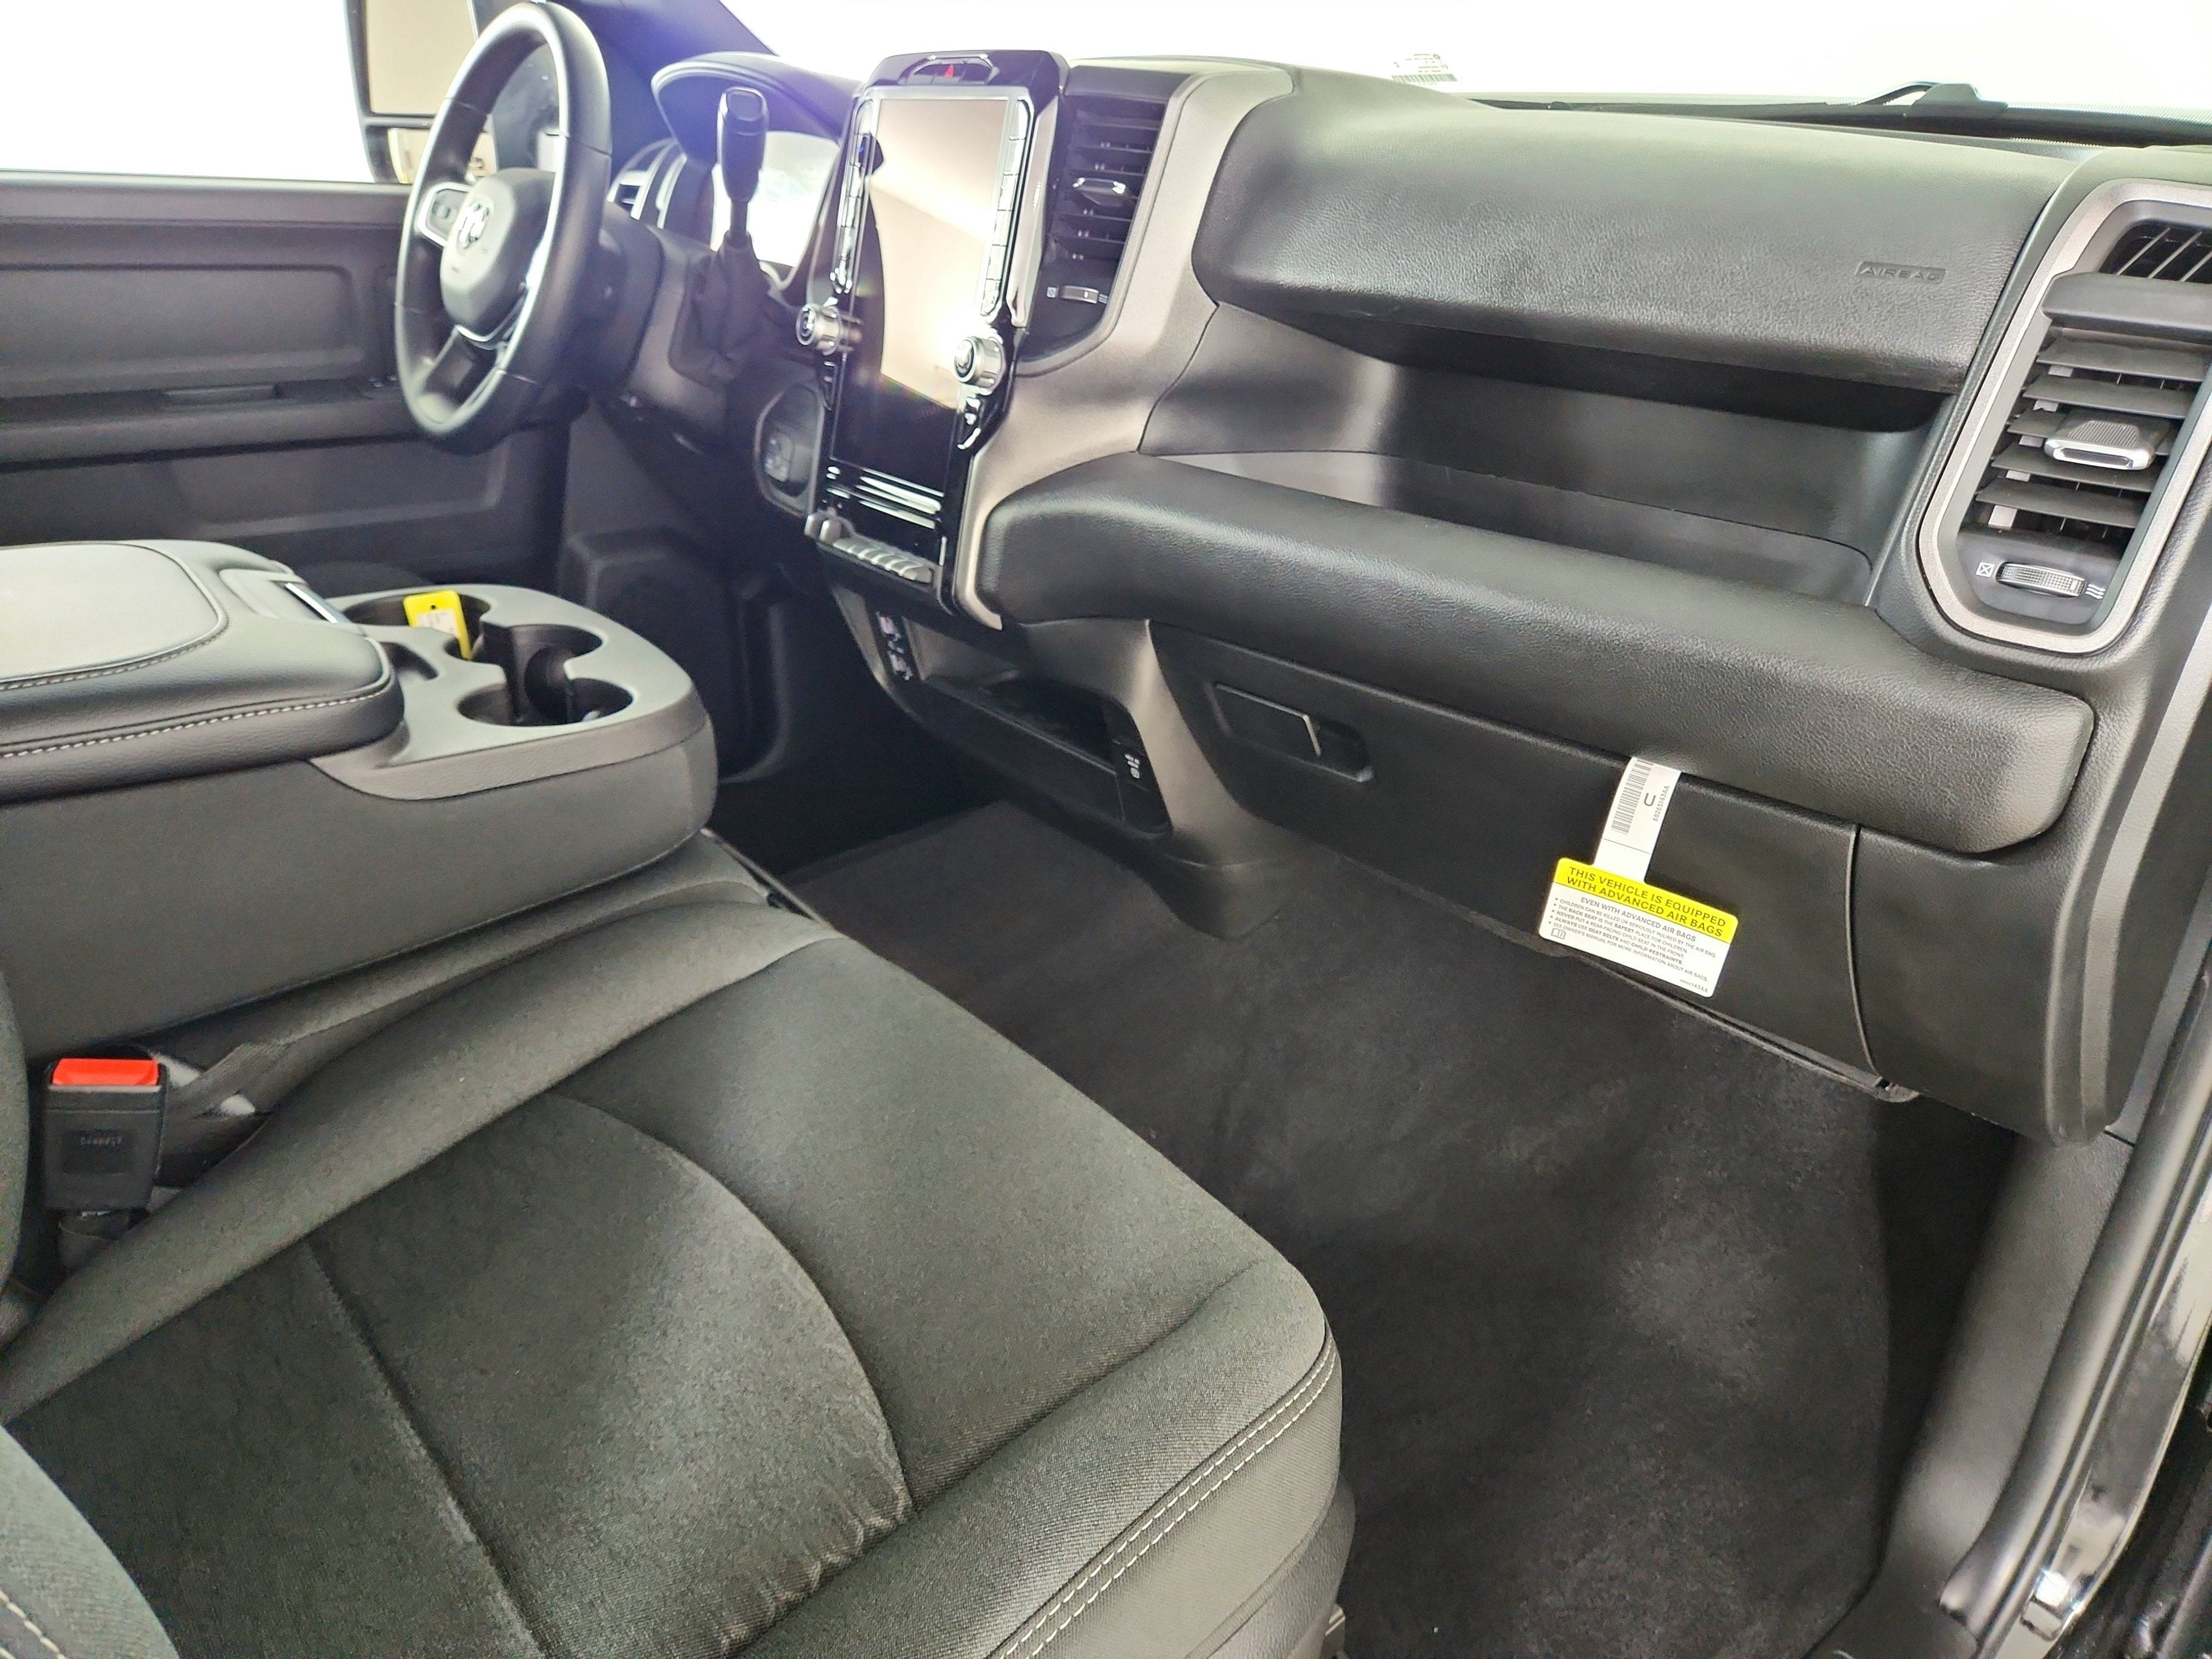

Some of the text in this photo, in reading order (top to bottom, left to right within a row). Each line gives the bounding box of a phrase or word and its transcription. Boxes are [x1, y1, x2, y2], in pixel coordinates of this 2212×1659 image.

[1860, 267, 1940, 280] AIRBAG
[1652, 786, 1670, 822] 68265143AA
[1566, 877, 1723, 938] WITH ADVANCED AIR BAGS
[1568, 867, 1726, 928] THIS VEHICLE IS EQUIPPED
[1555, 917, 1578, 928] ALWAYS
[1602, 933, 1619, 941] BELTS
[1630, 943, 1648, 952] CHILD
[1556, 911, 1575, 920] NEVER
[1622, 933, 1637, 941] CHILD
[1560, 899, 1584, 910] CHILDREN
[1603, 913, 1620, 922] KILLED
[1629, 922, 1656, 935] SERIOUSLY
[1568, 909, 1583, 917] BACK
[1614, 923, 1634, 934] SAFEST
[1635, 930, 1650, 940] PLACE
[1581, 897, 1696, 943] EVEN WITH ADVANCED AIR BAGS
[1585, 933, 1607, 944] MANUAL
[1633, 950, 1667, 965] INFORMATION
[1667, 962, 1684, 972] ABOUT
